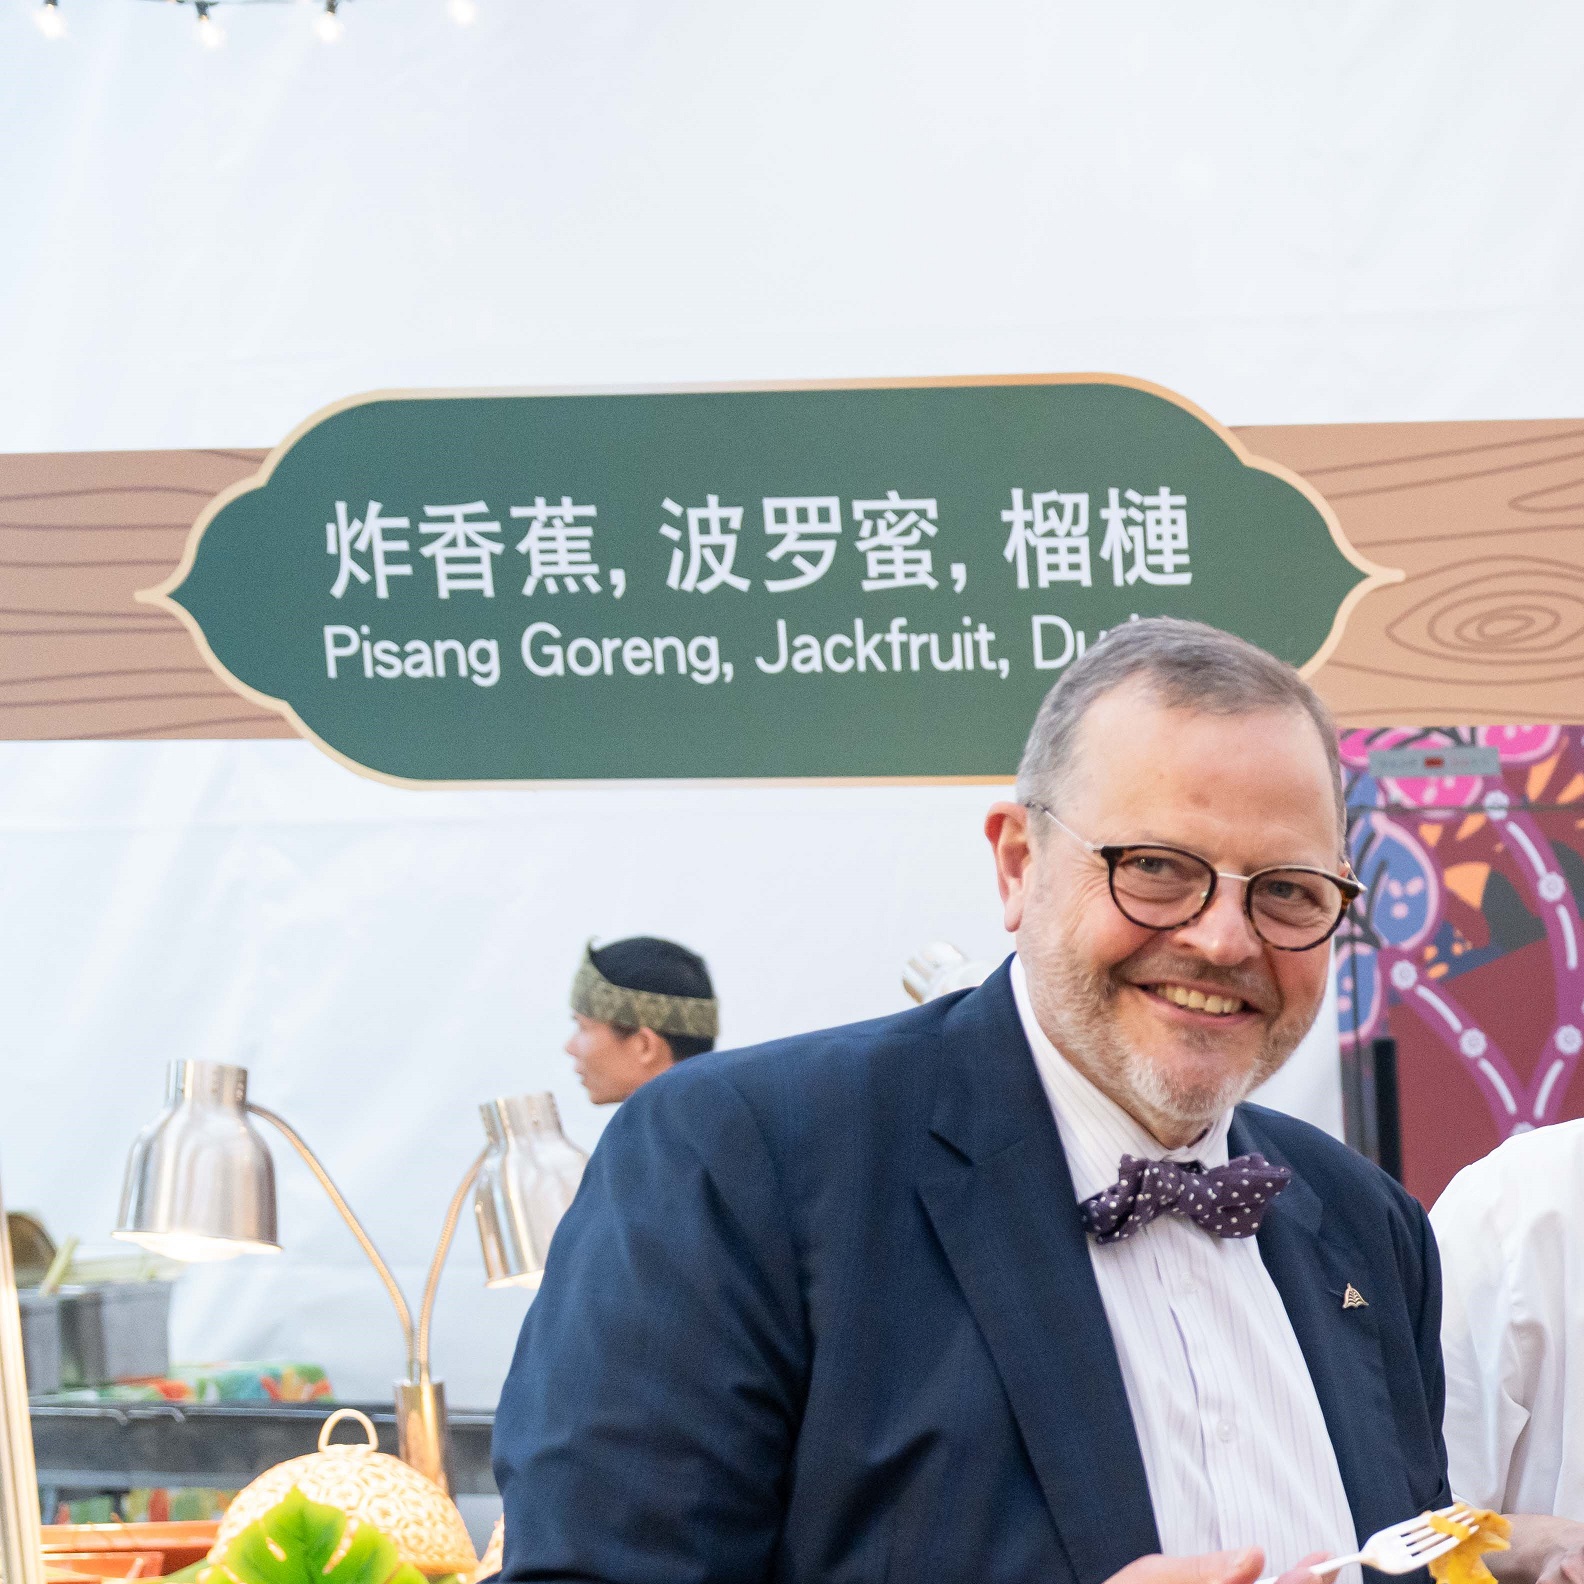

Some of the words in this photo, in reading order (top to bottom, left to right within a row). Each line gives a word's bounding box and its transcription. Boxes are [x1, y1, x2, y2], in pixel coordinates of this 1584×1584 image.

[326, 496, 626, 599] 炸香蕉,
[659, 490, 967, 594] 波罗蜜,
[1000, 486, 1193, 590] 榴槤
[323, 624, 501, 687] Pisang
[521, 622, 734, 685] Goreng,
[755, 616, 1010, 679] Jackfruit,
